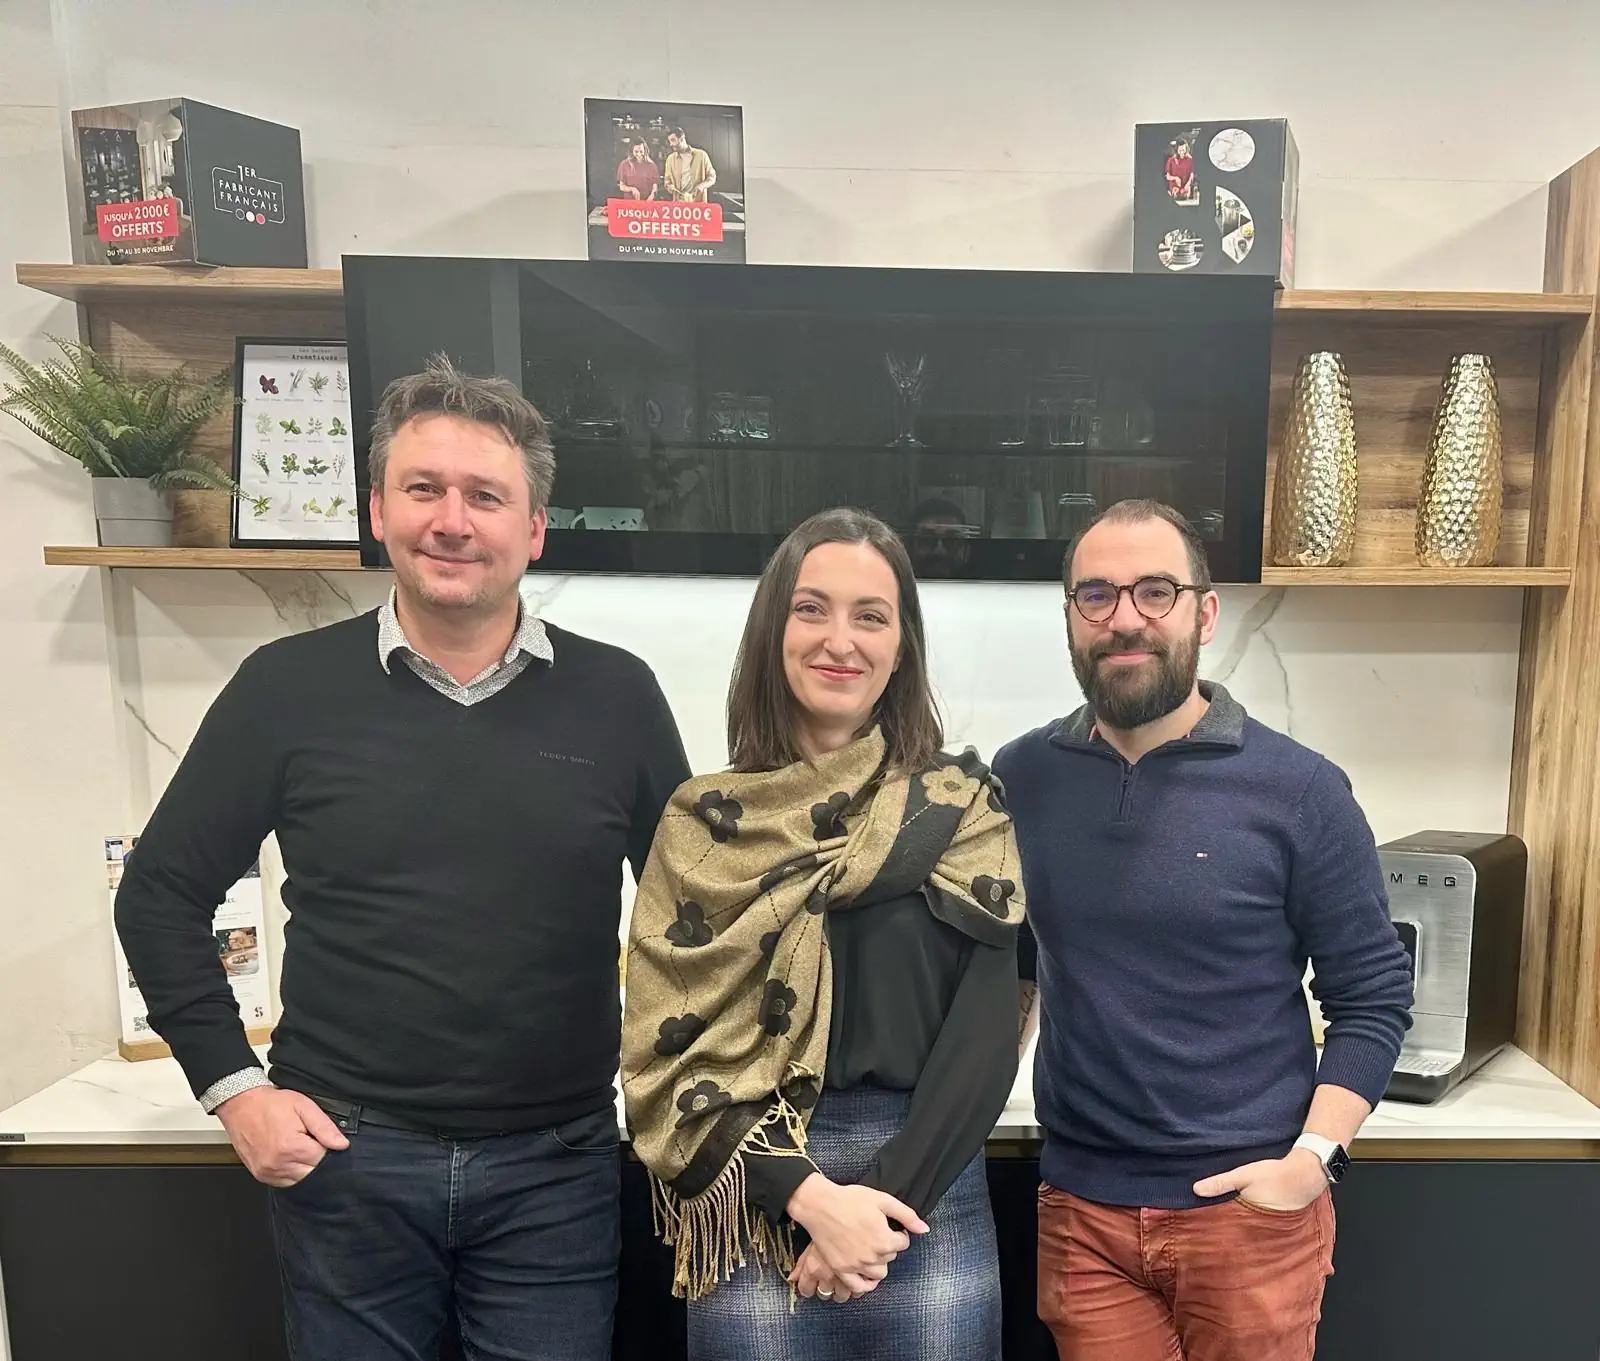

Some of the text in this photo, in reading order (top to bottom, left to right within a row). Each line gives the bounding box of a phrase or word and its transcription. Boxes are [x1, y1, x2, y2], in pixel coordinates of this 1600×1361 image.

[237, 165, 257, 182] 1ER
[219, 180, 276, 200] FABRICANT
[220, 191, 278, 212] FRANÇAIS
[112, 221, 163, 237] OFFERTS
[628, 221, 701, 237] OFFERTS
[142, 244, 174, 254] NOVEMBRE
[619, 245, 631, 253] DU
[669, 248, 714, 256] NOVEMBRE
[1390, 872, 1457, 887] MEG
